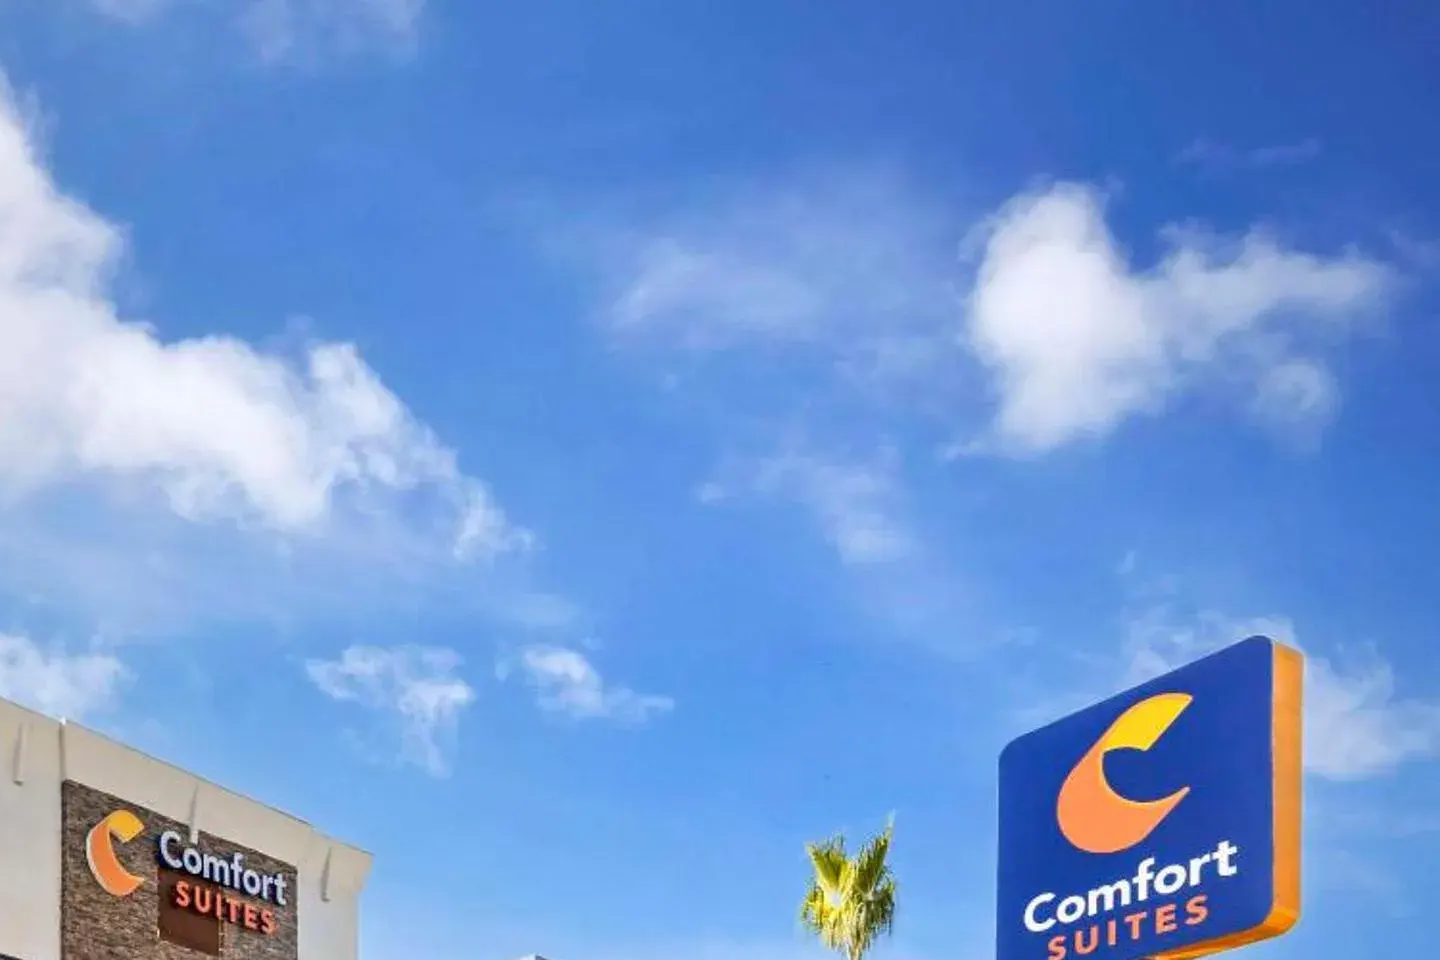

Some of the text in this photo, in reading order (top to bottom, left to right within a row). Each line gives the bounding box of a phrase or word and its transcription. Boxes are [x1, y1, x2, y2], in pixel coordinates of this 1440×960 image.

[158, 830, 287, 905] Comfort
[1024, 840, 1238, 932] Comfort
[175, 880, 278, 935] SUITES
